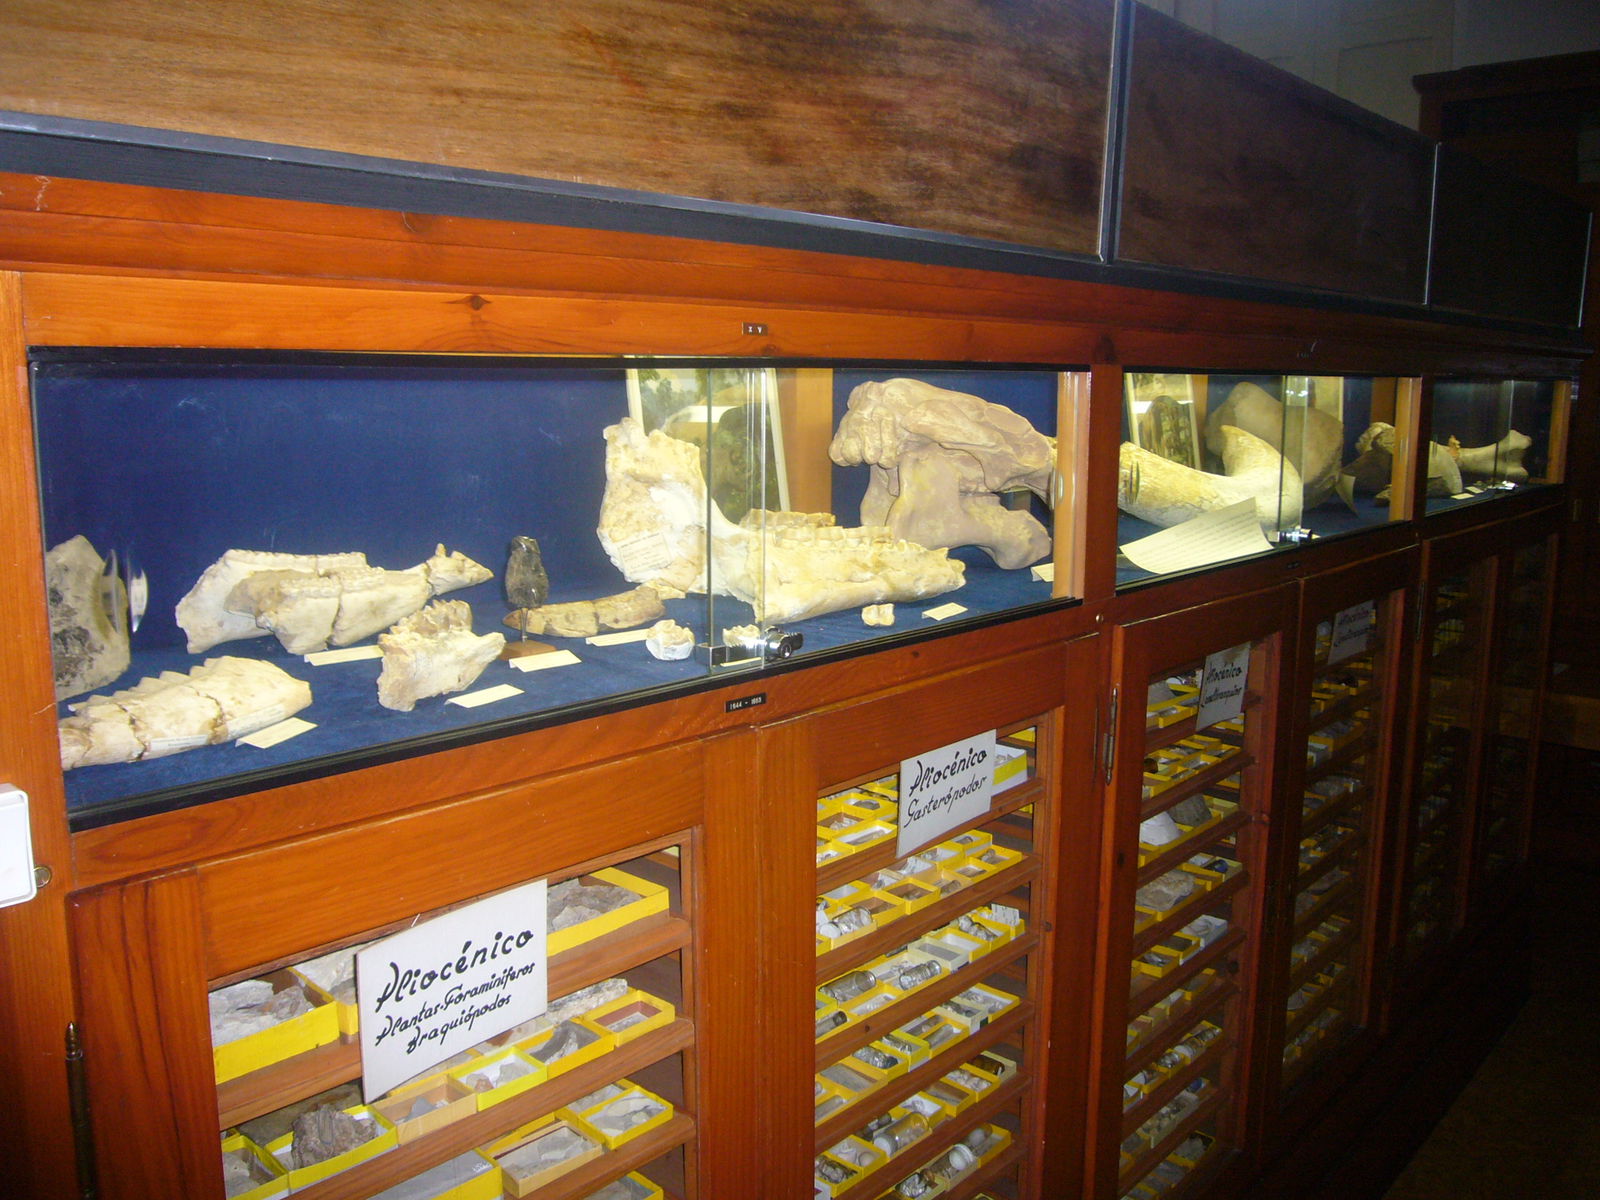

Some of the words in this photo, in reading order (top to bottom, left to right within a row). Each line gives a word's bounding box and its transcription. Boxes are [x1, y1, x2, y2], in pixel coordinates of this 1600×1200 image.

[903, 773, 988, 829] Gasterópodos
[908, 747, 988, 798] Pliocénico
[375, 929, 534, 1014] Pliocénico
[406, 993, 512, 1055] Braquiópodos
